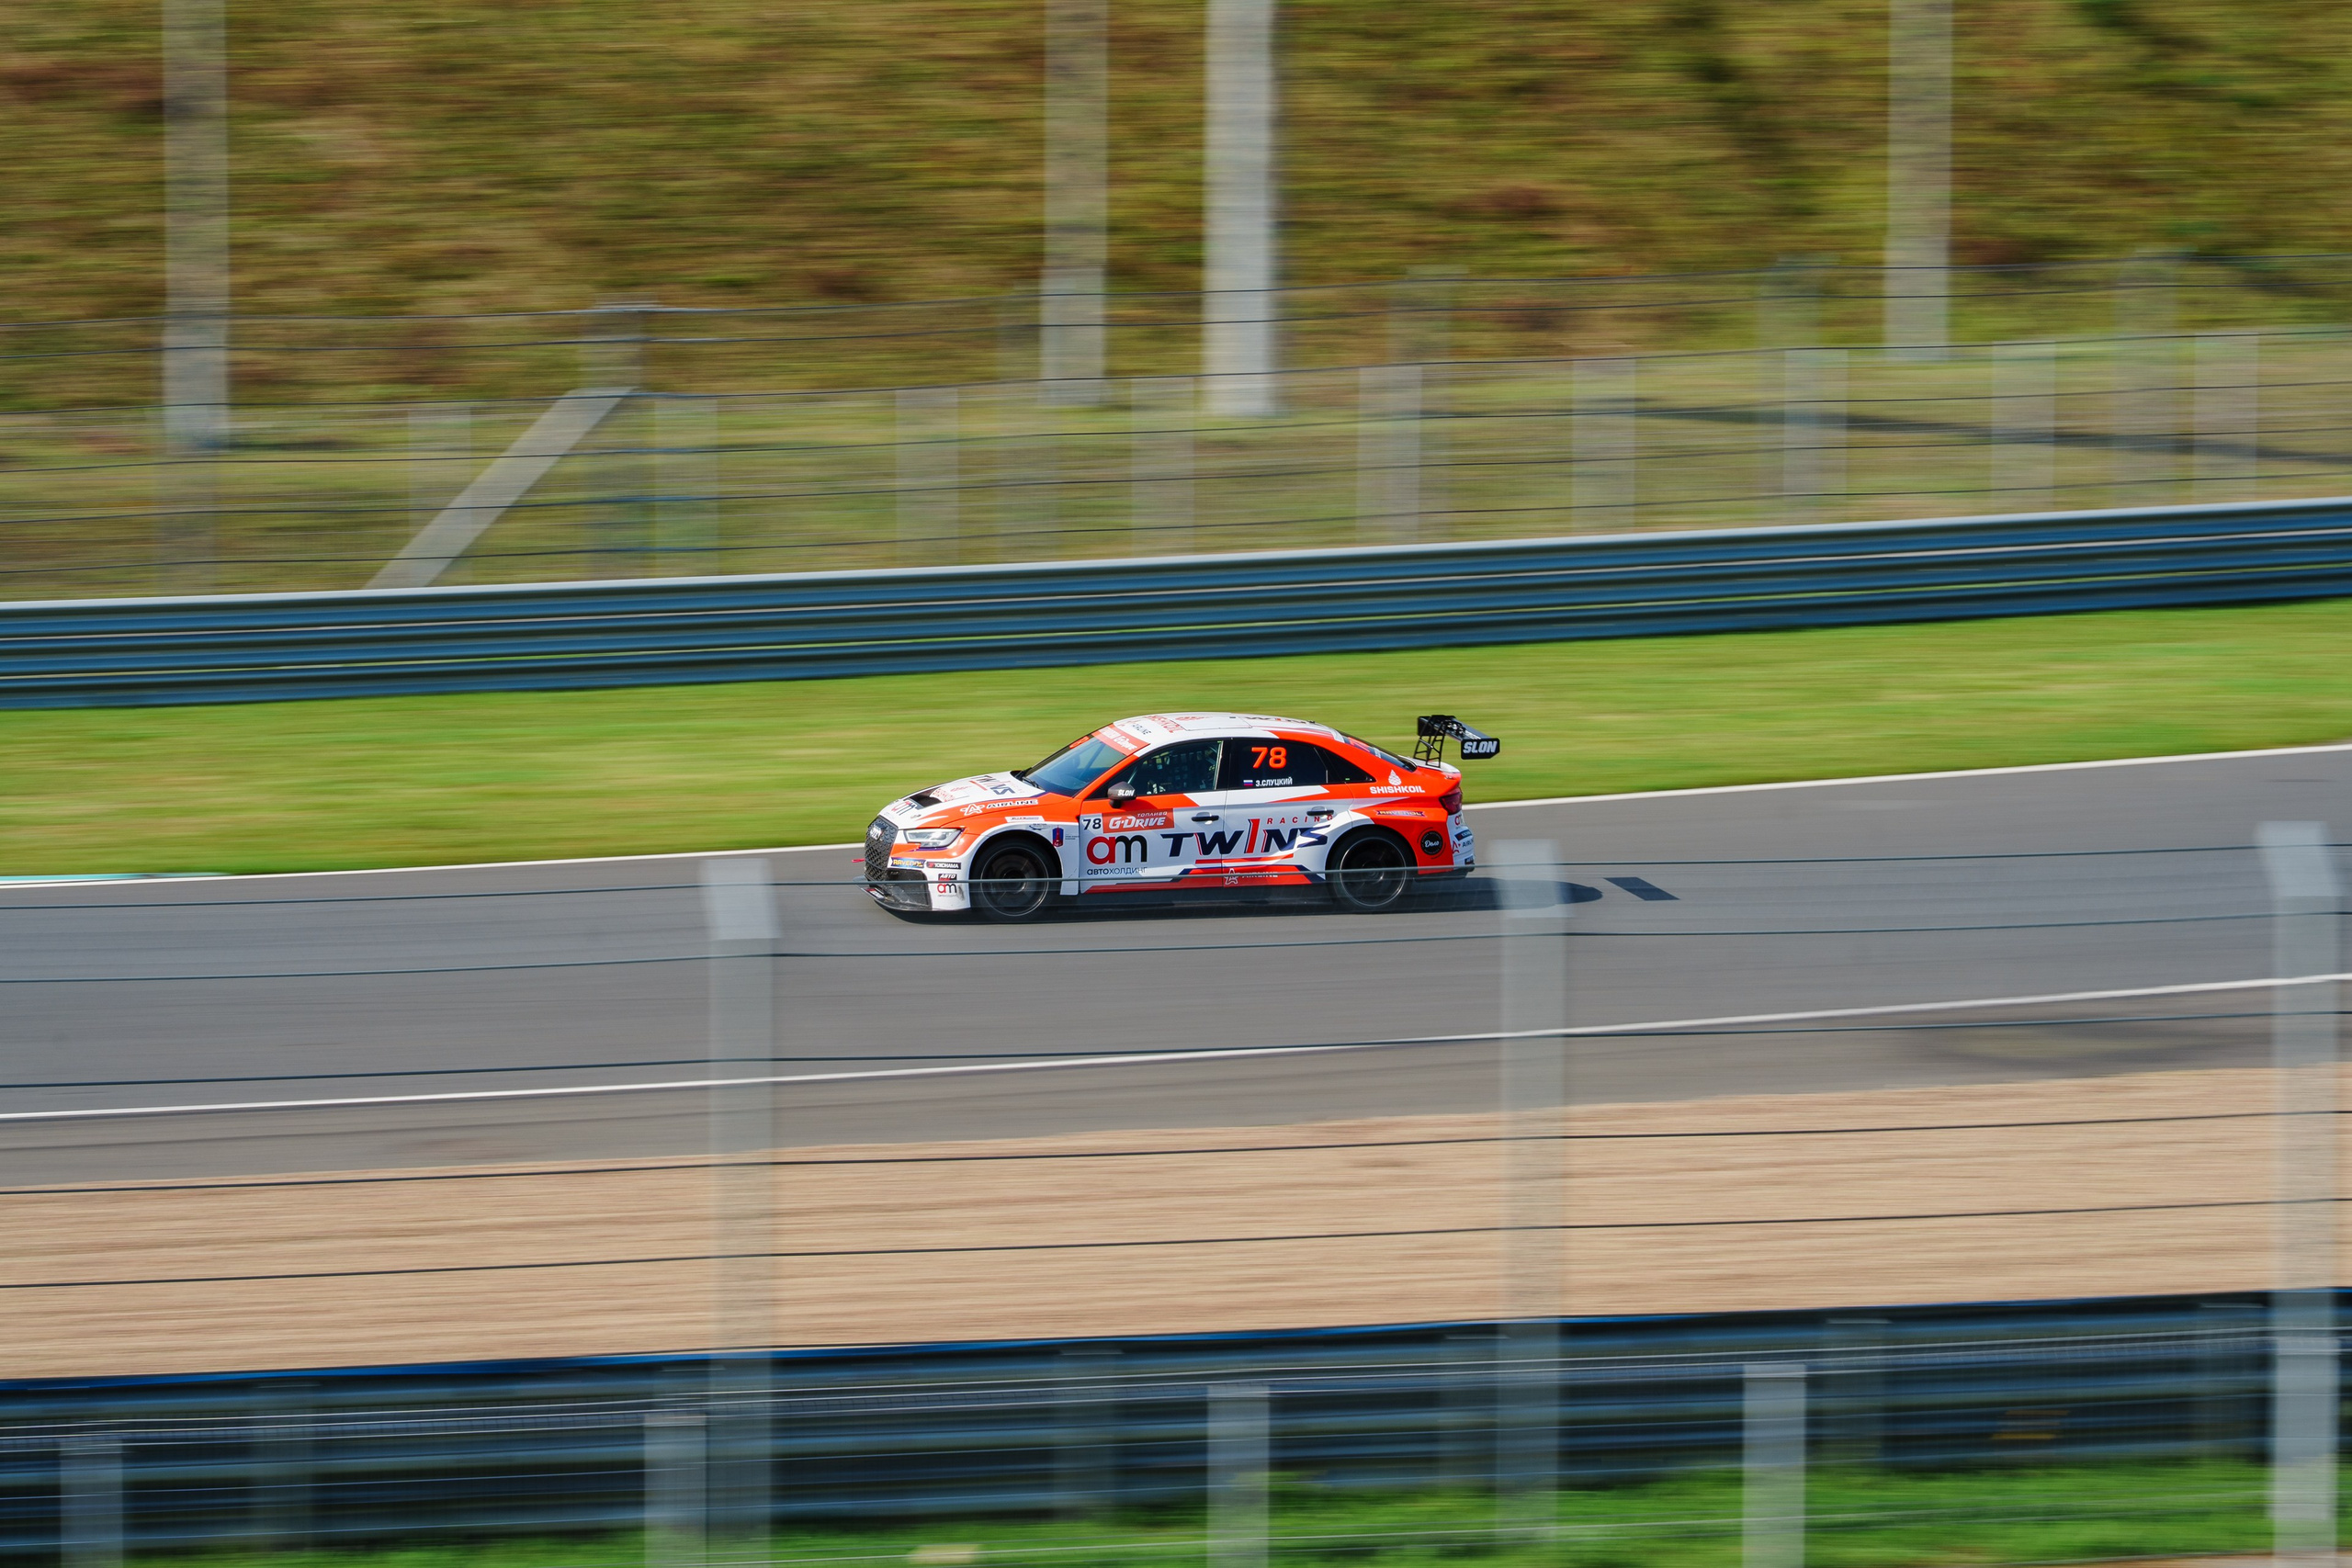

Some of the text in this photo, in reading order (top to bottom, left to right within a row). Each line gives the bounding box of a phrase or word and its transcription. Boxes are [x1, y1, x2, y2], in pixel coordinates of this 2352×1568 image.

[1463, 740, 1498, 754] SLON
[1251, 747, 1287, 769] 78
[1369, 785, 1426, 795] SHISHKOIL
[987, 799, 1038, 809] AIRLINE
[1082, 818, 1102, 830] 78
[1266, 814, 1333, 825] RACING
[1160, 818, 1331, 858] TWINS
[1086, 834, 1148, 865] am
